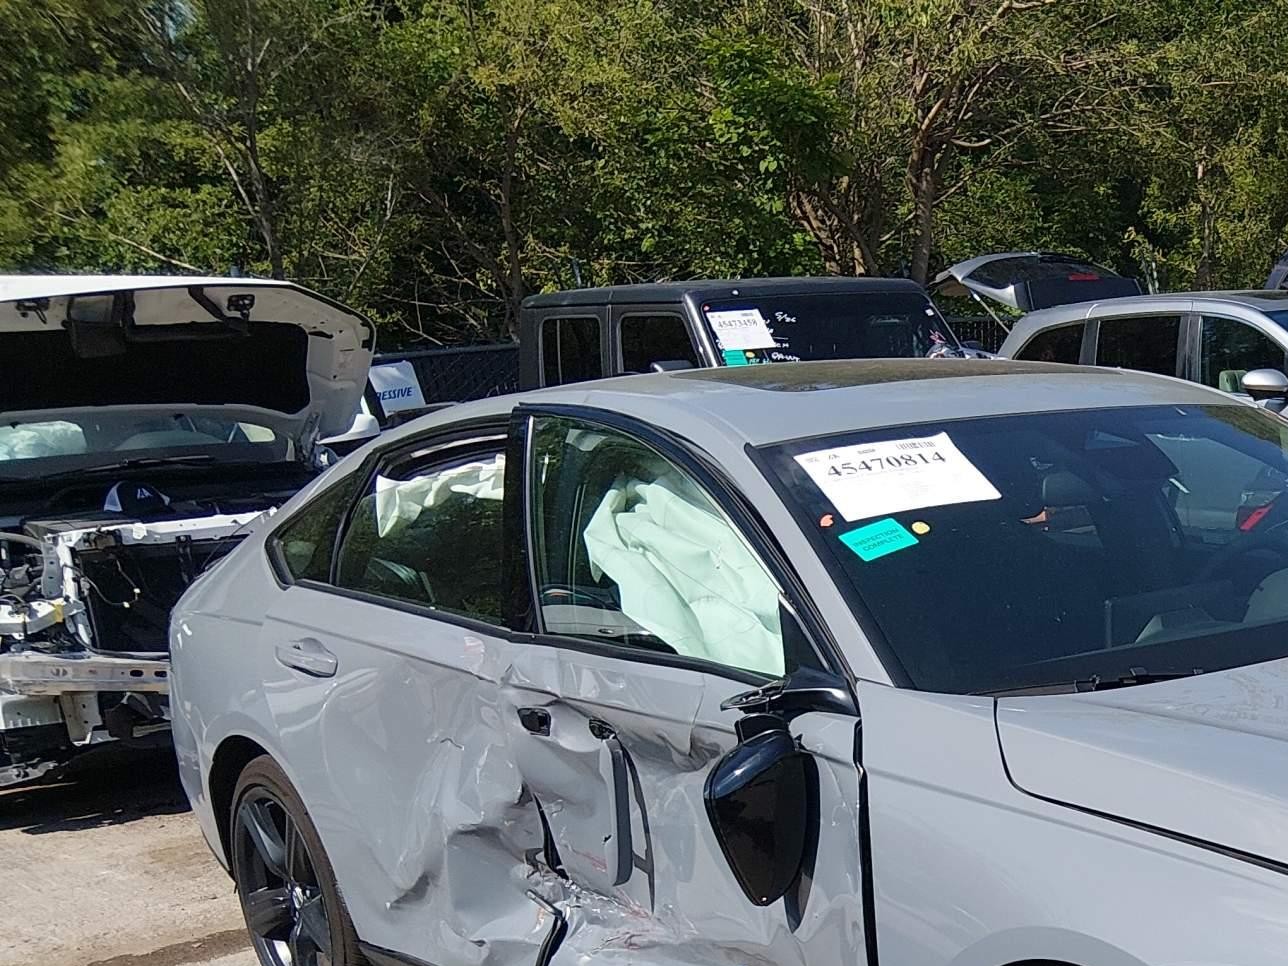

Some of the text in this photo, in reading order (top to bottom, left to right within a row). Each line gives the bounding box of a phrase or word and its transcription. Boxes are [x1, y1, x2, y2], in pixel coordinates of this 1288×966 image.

[826, 451, 947, 477] 45470814
[852, 527, 900, 547] INSPECTION
[862, 534, 904, 552] COMPLETE
